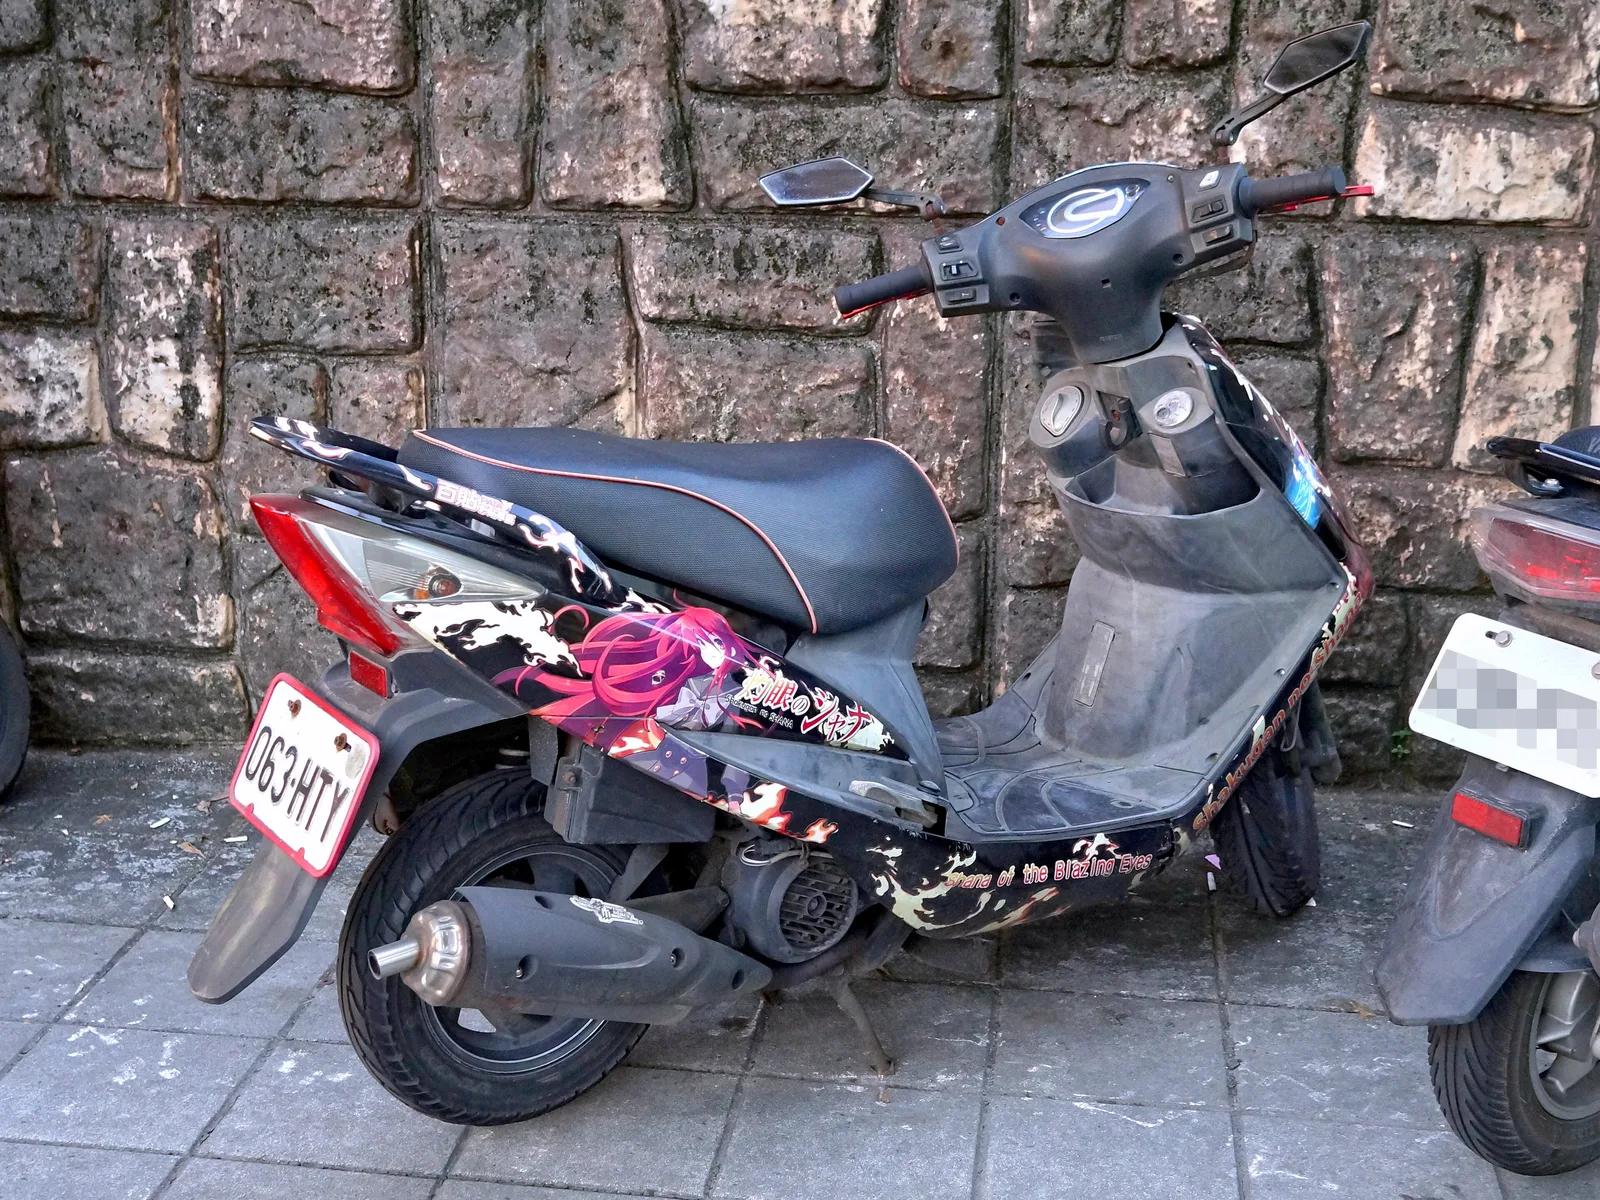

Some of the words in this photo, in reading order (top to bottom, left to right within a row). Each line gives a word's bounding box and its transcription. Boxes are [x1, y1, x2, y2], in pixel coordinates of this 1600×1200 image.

[735, 668, 873, 742] 灼眼のシャナ
[997, 865, 1016, 887] of
[1023, 863, 1048, 884] the
[1054, 858, 1115, 881] Blazing
[1119, 853, 1153, 874] Eyes
